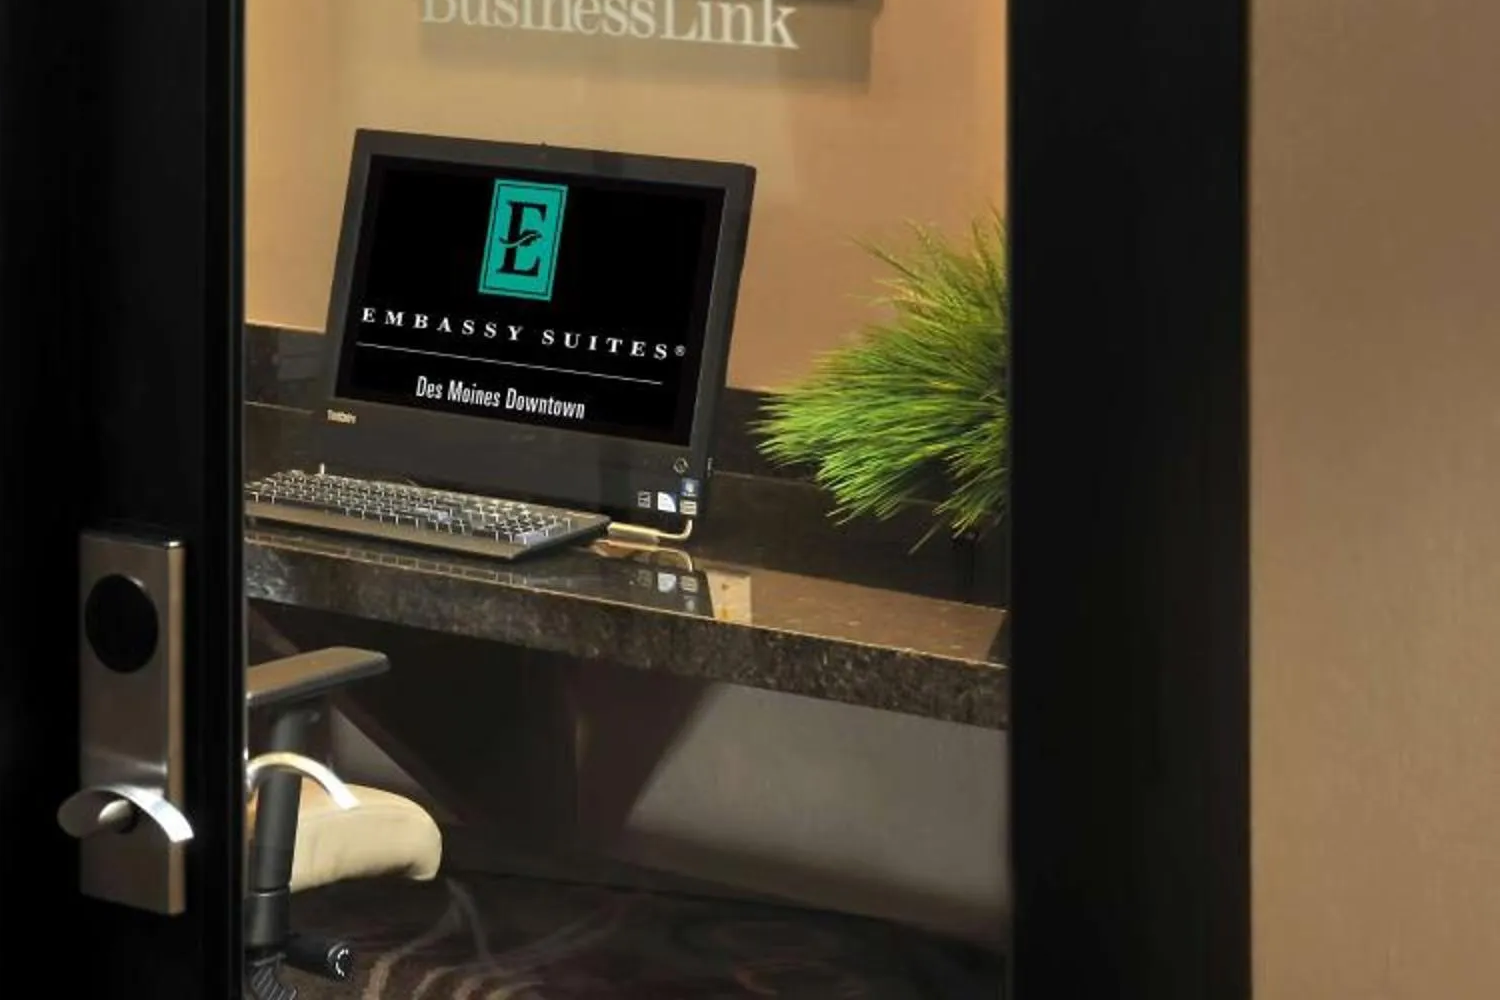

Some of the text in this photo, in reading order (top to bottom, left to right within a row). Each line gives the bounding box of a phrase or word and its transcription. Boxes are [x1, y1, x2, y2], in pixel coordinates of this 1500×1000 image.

[362, 307, 524, 342] EMBASSY
[416, 375, 586, 421] Des Moines Downtown
